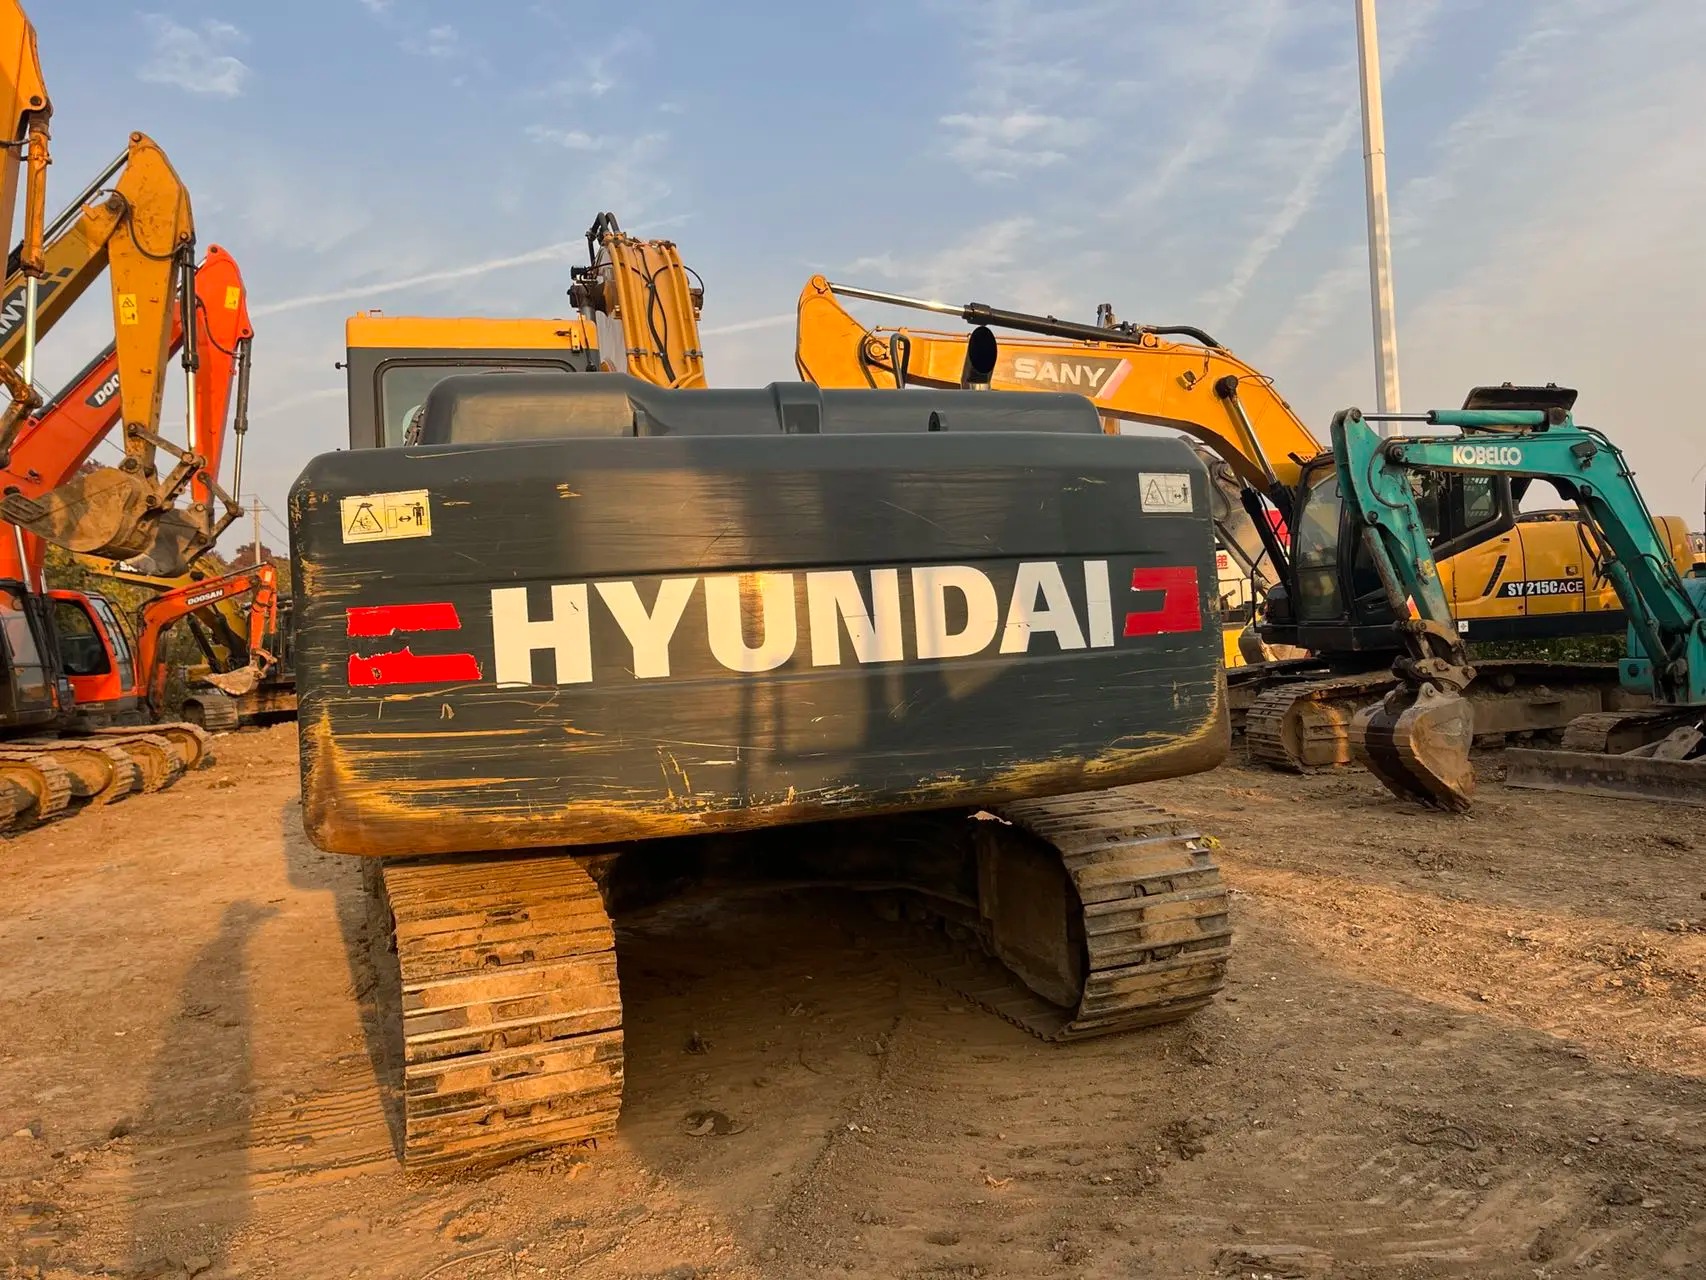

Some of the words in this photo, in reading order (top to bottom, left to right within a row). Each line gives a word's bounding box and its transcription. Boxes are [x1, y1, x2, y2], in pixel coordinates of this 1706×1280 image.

[1015, 358, 1105, 387] SANY
[1453, 446, 1521, 465] KOBELCO
[188, 590, 223, 605] DOOSAN
[1507, 583, 1524, 596] SY
[491, 561, 1114, 688] HYUNDAI
